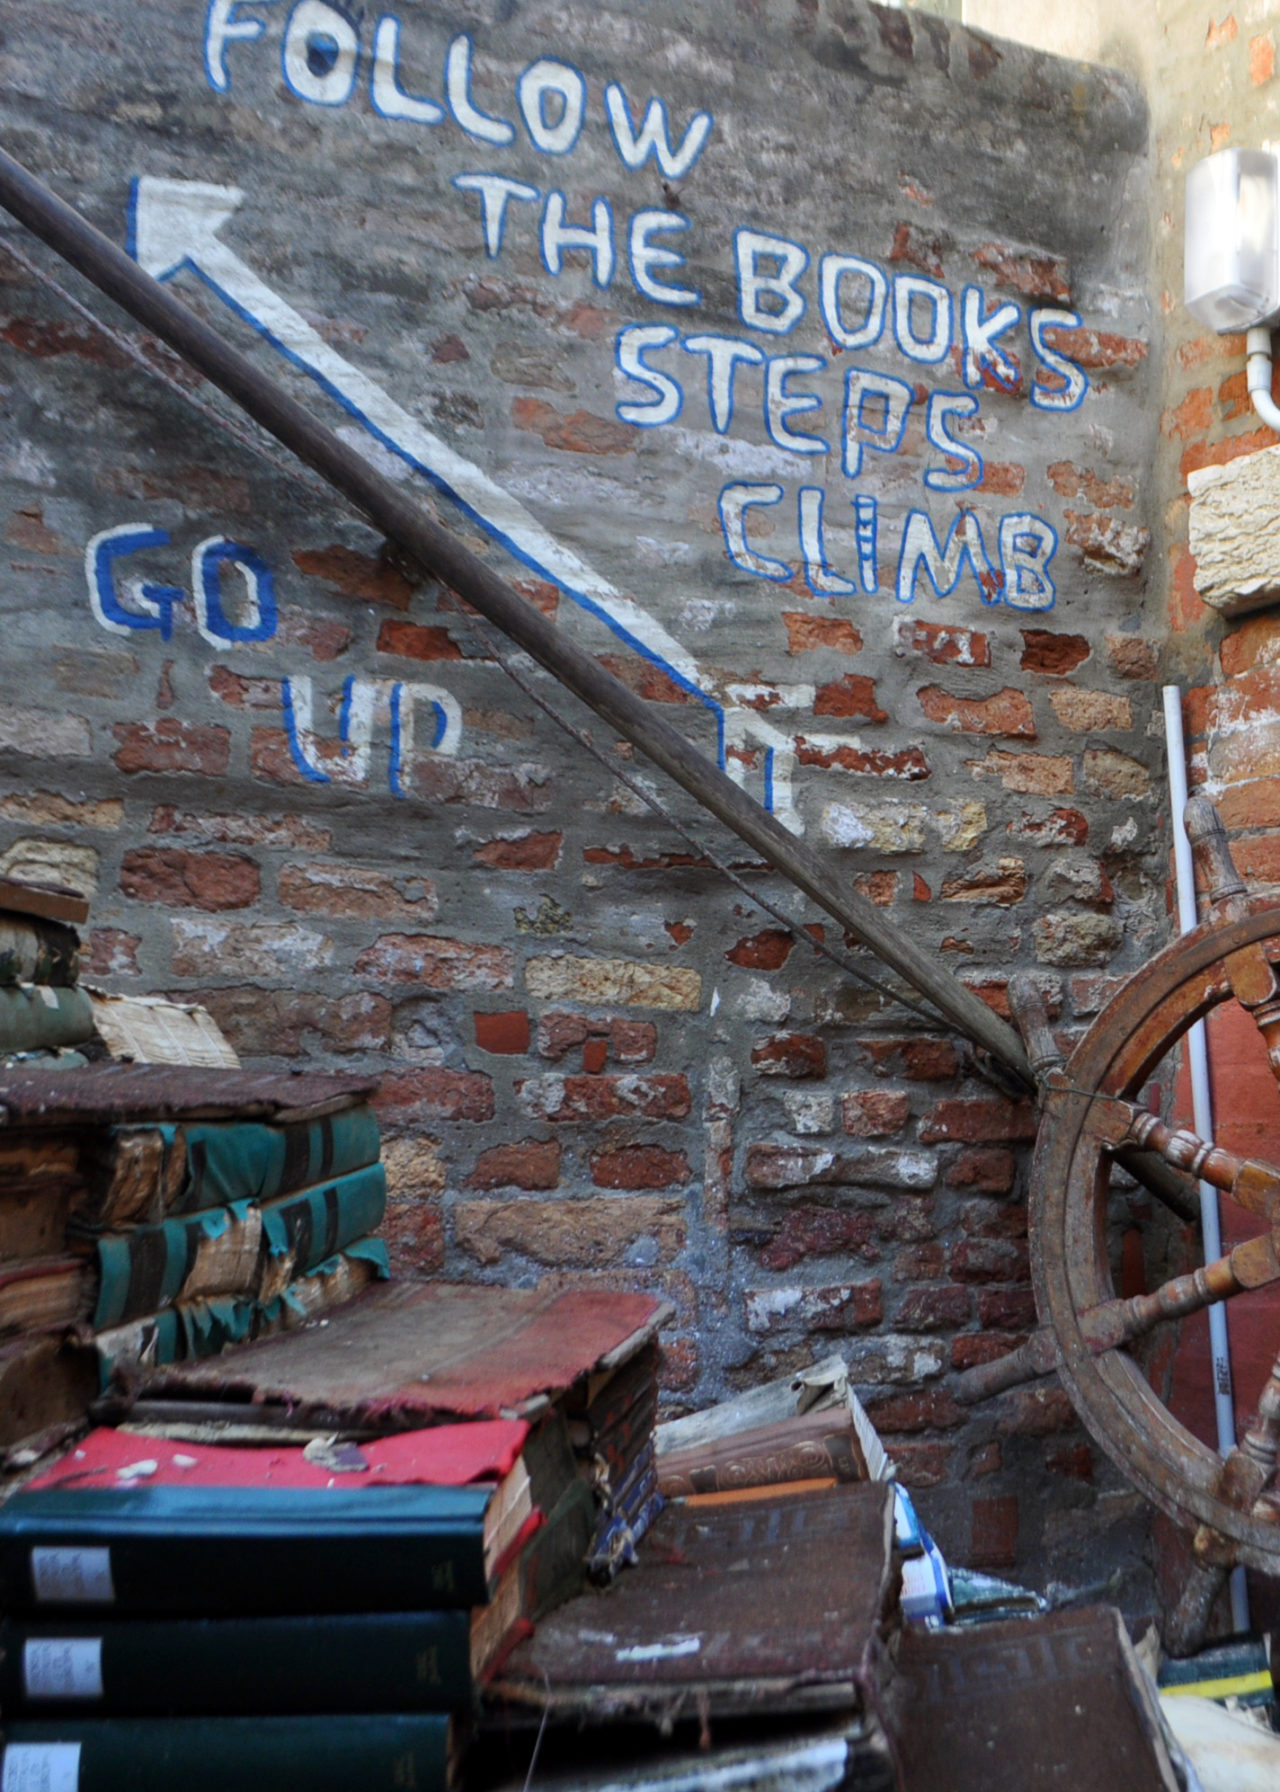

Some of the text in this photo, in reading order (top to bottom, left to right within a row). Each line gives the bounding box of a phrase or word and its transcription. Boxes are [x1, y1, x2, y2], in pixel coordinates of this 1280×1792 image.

[204, 0, 713, 179] FOLLOW
[452, 172, 1089, 411] THE BOOKS
[614, 321, 984, 492] STEPS
[84, 522, 278, 651] GO
[716, 480, 1057, 612] CLIMB
[280, 673, 463, 798] UP
